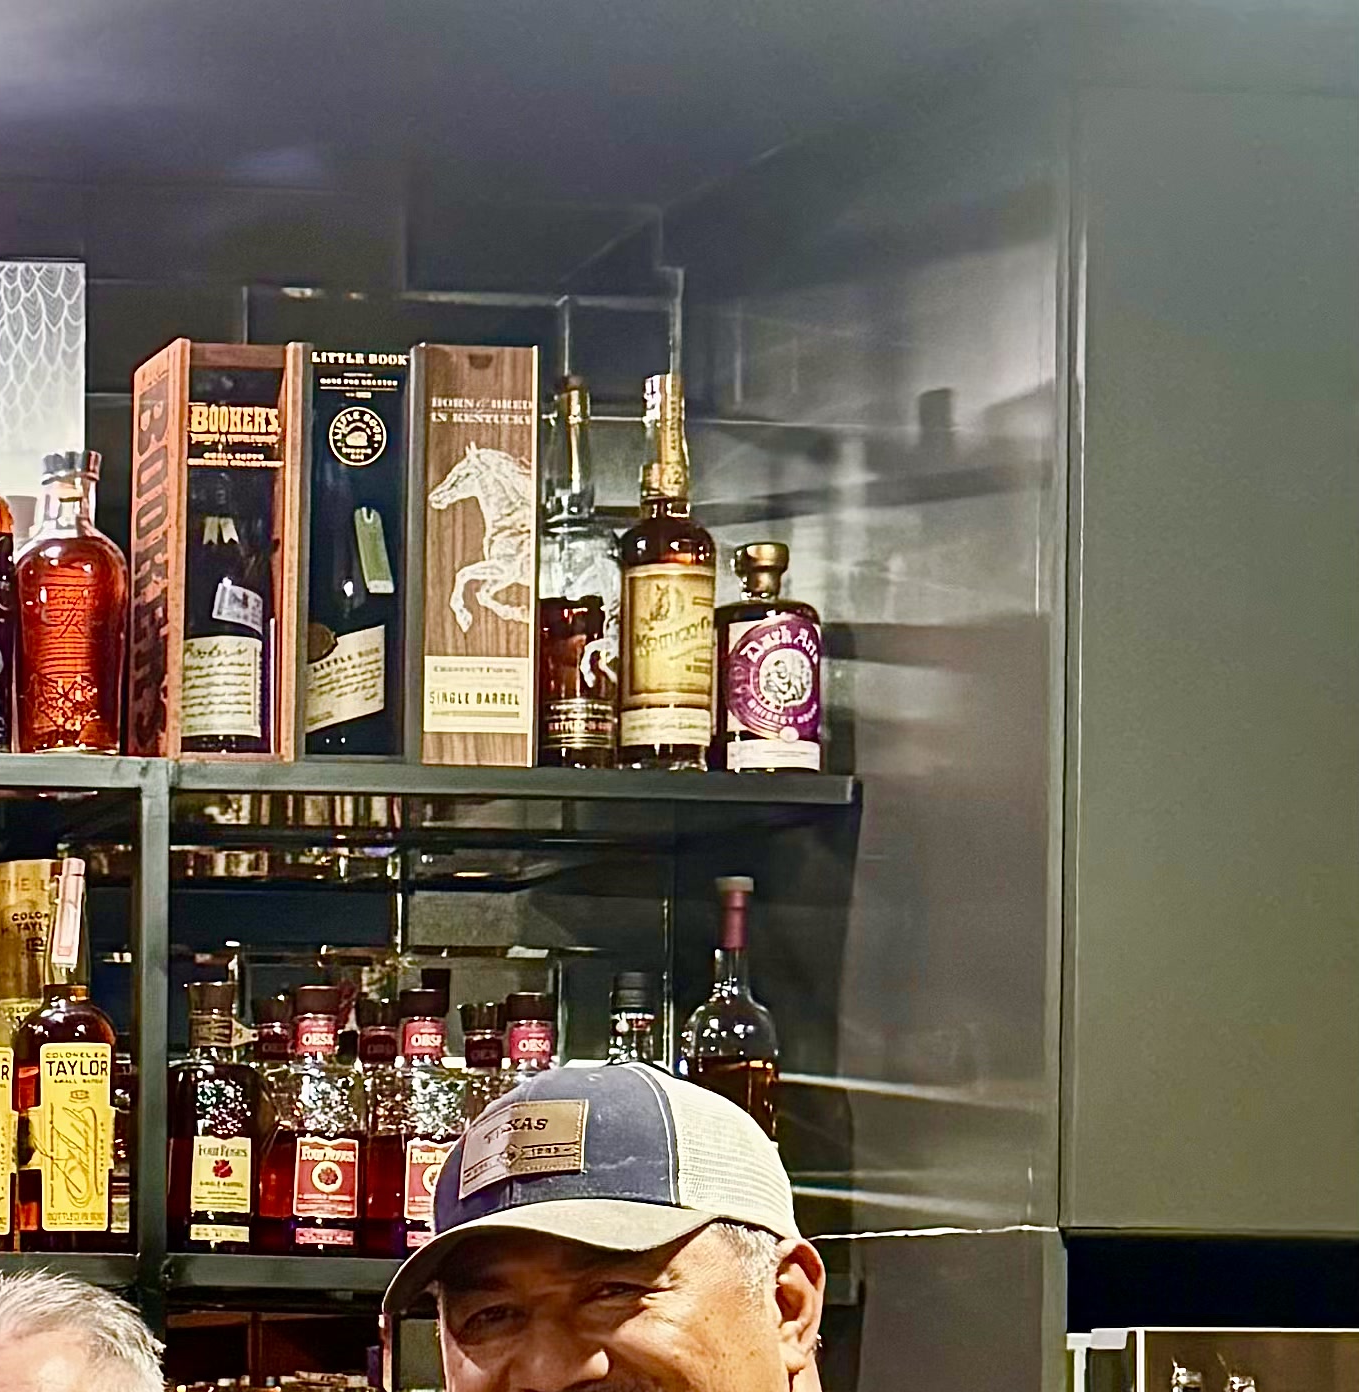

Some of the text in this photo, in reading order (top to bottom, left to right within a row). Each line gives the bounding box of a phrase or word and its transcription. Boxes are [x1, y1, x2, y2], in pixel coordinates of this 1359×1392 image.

[311, 351, 409, 366] LITTLE BOOK
[190, 404, 280, 433] BOOKER'S
[431, 412, 447, 422] IN
[740, 625, 792, 663] Dark
[429, 690, 521, 707] SINGLE BARREL
[12, 911, 50, 923] COLON
[16, 921, 49, 932] TAYL
[45, 1060, 109, 1077] TAYLOR
[484, 1116, 550, 1144] TXAS
